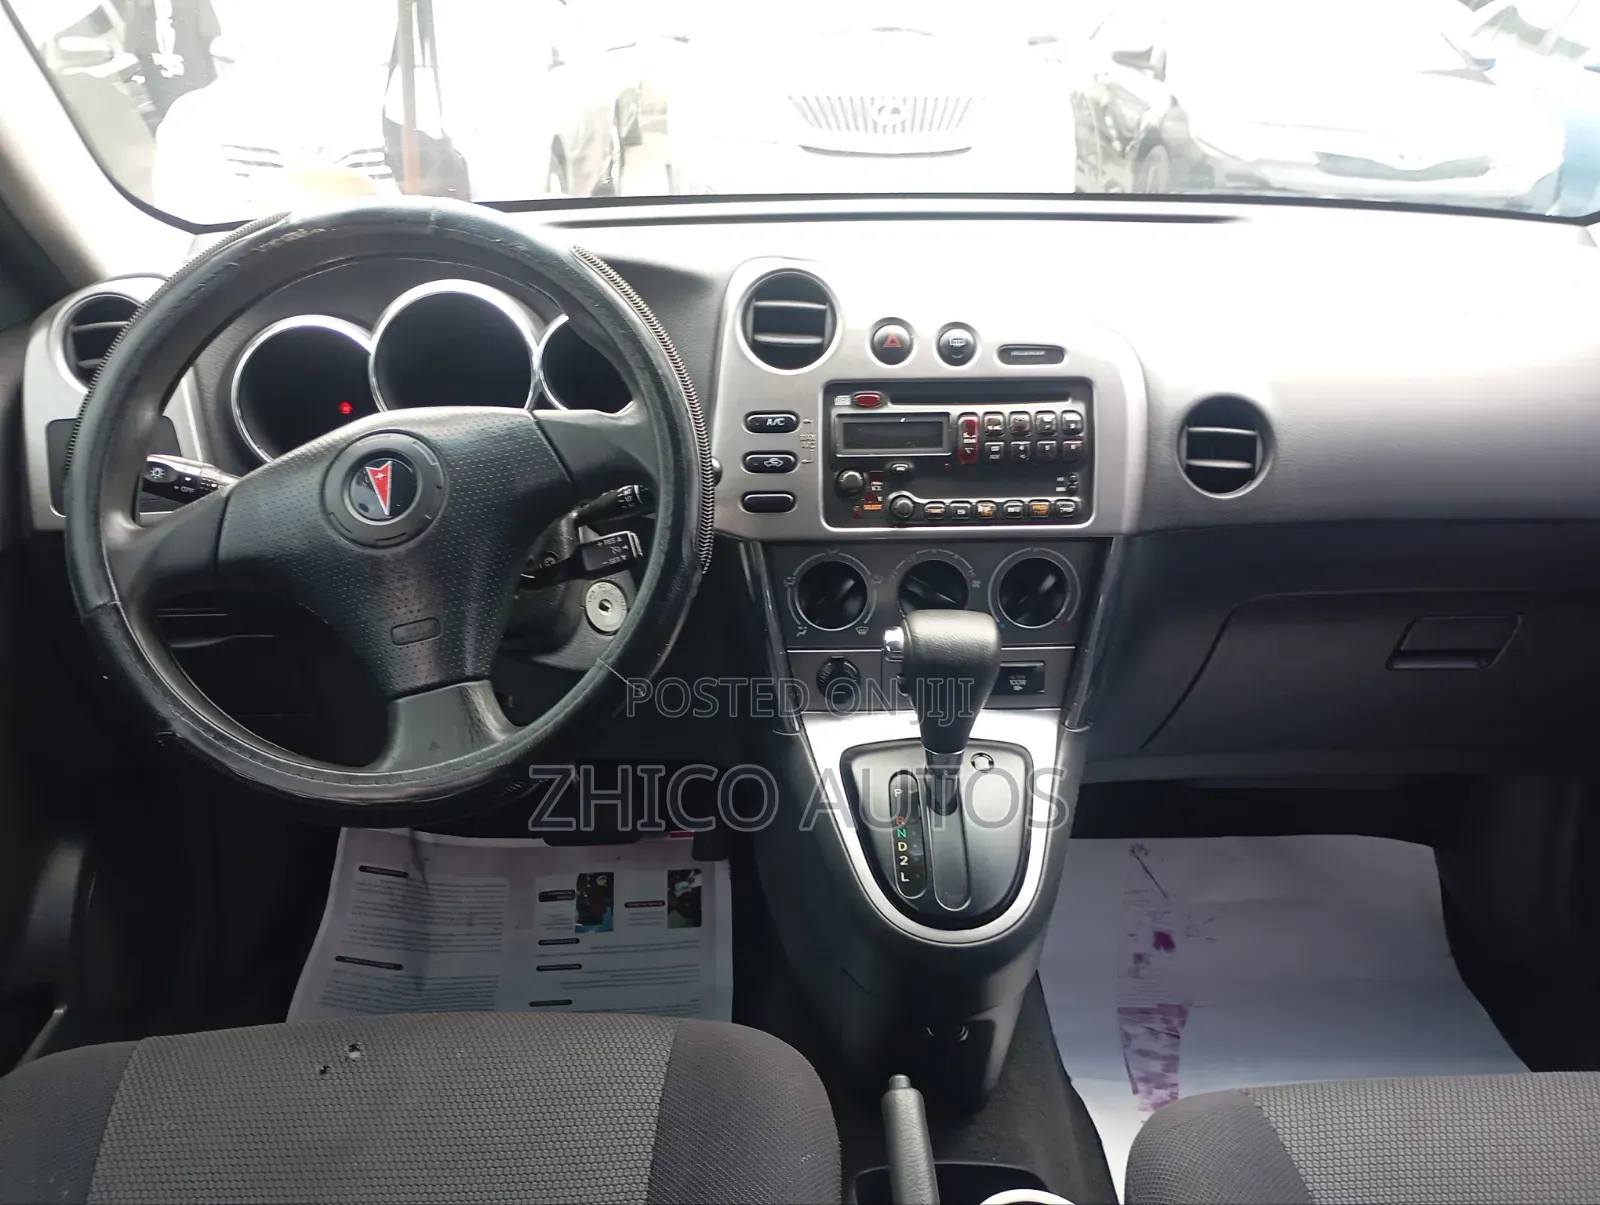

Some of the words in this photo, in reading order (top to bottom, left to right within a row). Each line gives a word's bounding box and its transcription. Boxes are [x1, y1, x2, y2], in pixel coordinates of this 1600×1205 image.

[766, 418, 786, 426] A/C
[893, 788, 903, 798] P
[896, 816, 905, 825] R
[897, 828, 907, 838] N
[898, 842, 908, 852] D
[899, 855, 909, 866] 2
[900, 872, 910, 882] L
